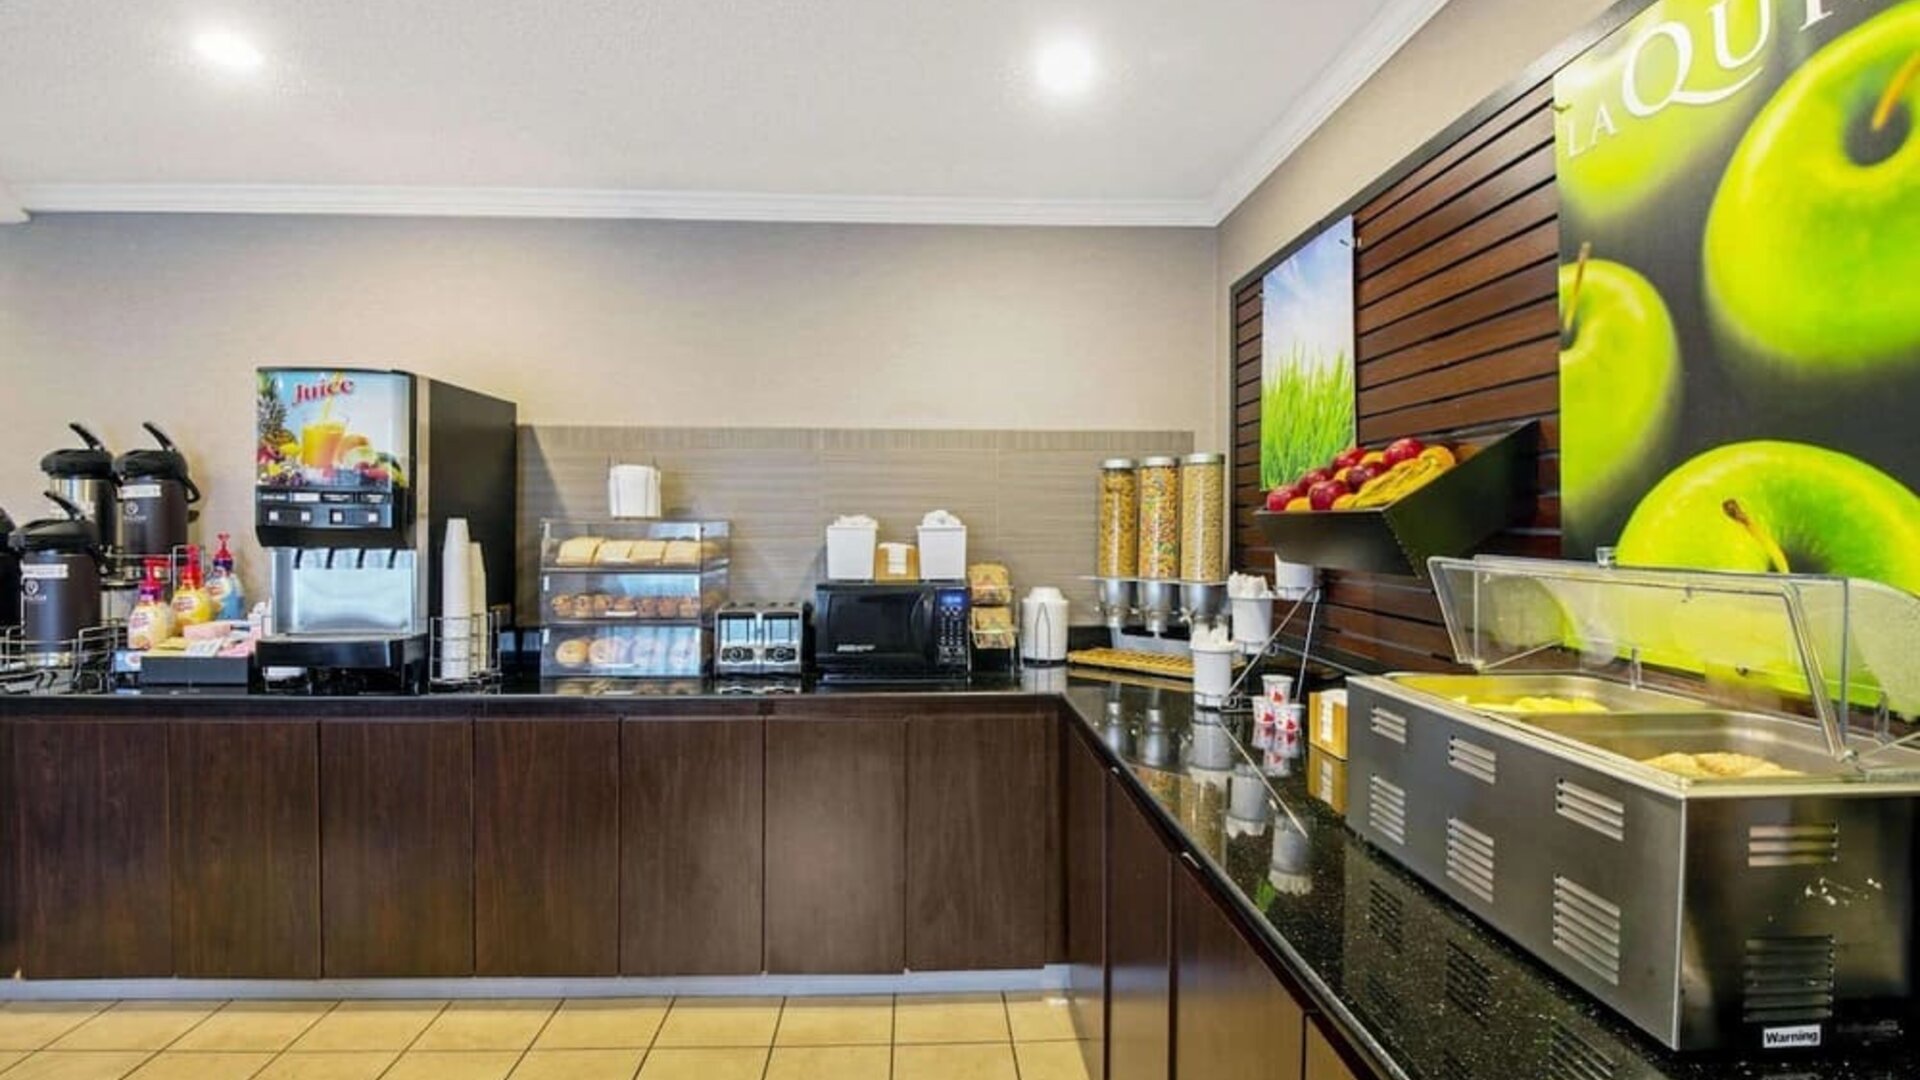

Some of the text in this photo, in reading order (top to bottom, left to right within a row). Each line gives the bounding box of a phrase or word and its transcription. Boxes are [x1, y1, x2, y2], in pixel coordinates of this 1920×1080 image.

[1565, 102, 1617, 158] LA
[291, 379, 355, 408] Juice
[1765, 1030, 1819, 1044] Warning
